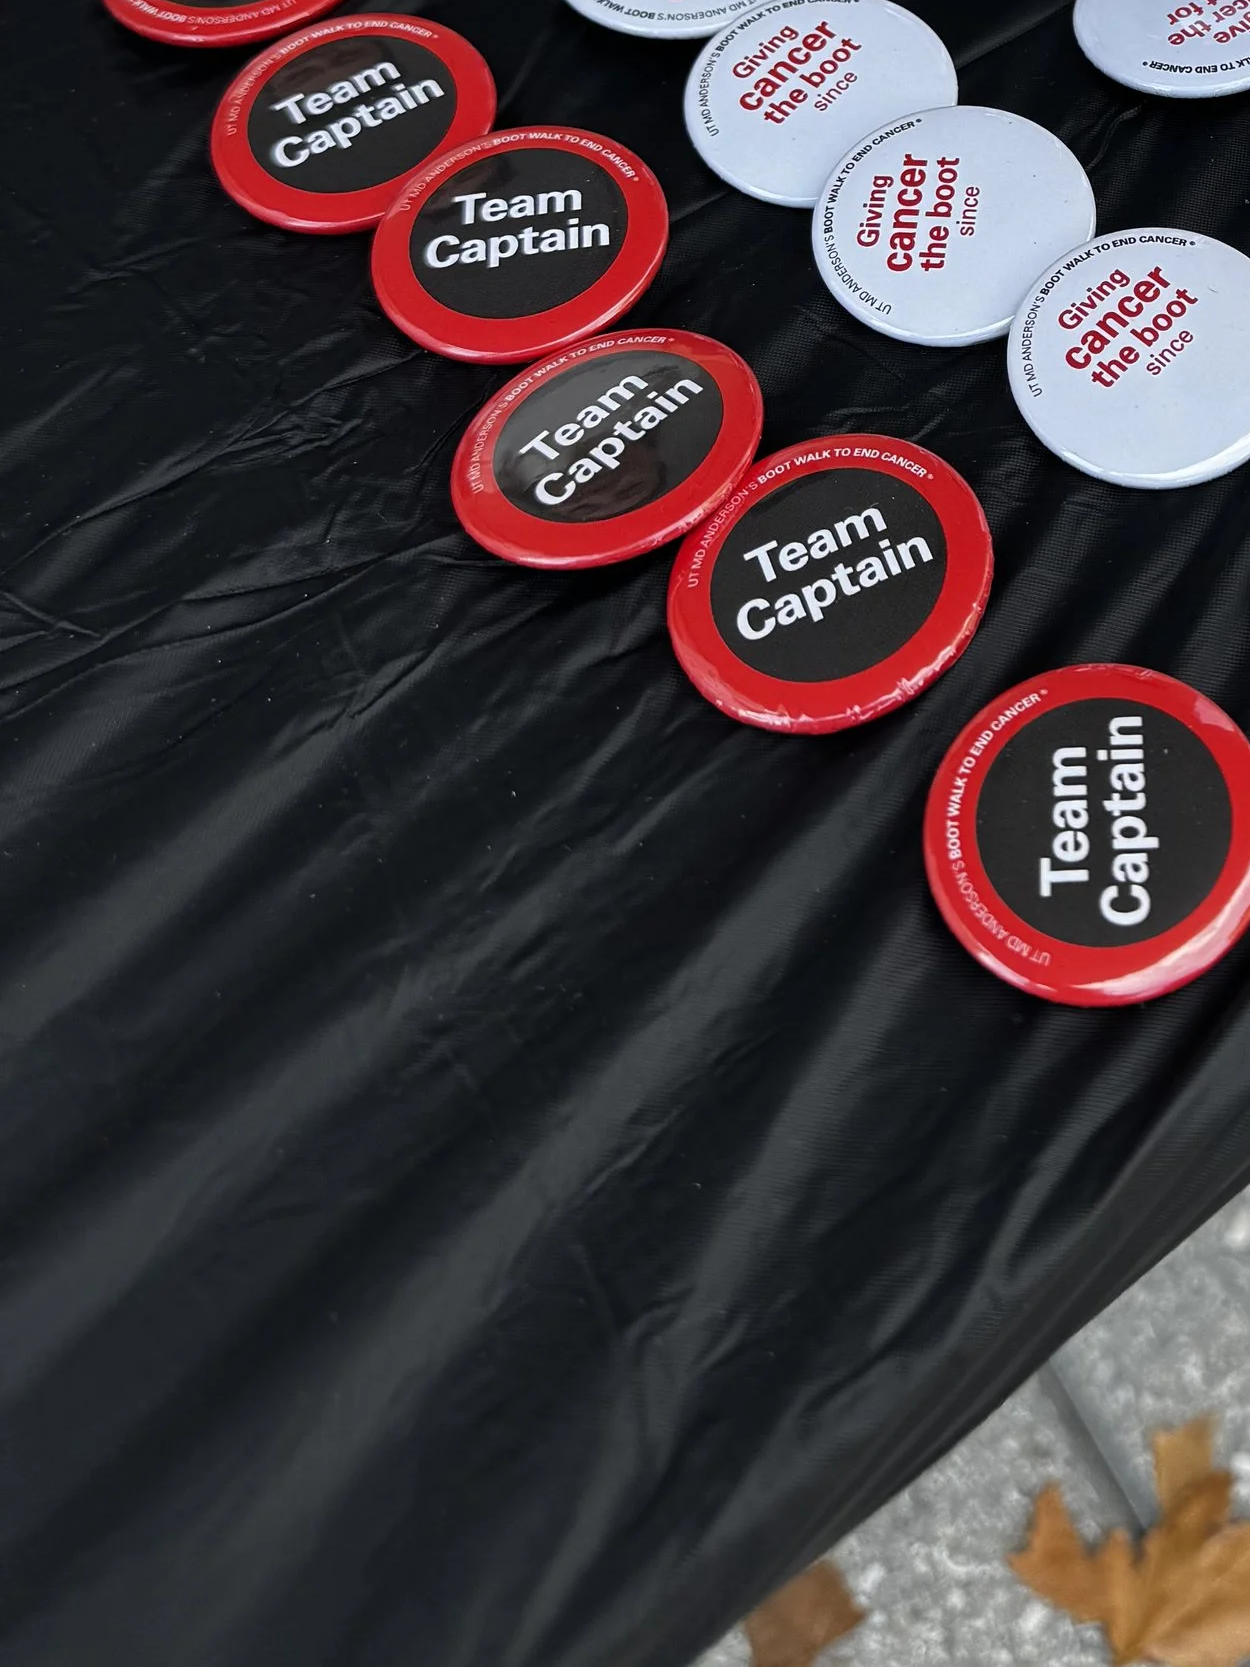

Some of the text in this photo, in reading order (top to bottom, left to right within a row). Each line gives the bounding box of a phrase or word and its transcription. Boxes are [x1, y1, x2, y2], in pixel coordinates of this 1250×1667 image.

[1167, 2, 1204, 25] for
[1167, 19, 1212, 46] the
[732, 24, 800, 80] Giving
[738, 20, 842, 112] cancer
[764, 37, 862, 125] the boot
[271, 61, 401, 126] Team
[273, 76, 445, 169] Captain
[814, 71, 859, 112] since
[453, 188, 583, 226] Team
[857, 175, 894, 248] Giving
[887, 154, 928, 273] cancer
[919, 157, 961, 273] the boot
[957, 186, 981, 237] since
[423, 218, 611, 270] Captain
[1057, 268, 1130, 331] Giving
[1065, 266, 1171, 370] cancer
[1091, 287, 1199, 389] the boot
[1146, 329, 1194, 376] since
[519, 375, 650, 462] Team
[534, 377, 704, 507] Captain
[757, 461, 791, 485] BOOT
[793, 449, 831, 465] WALK
[834, 448, 851, 457] TO
[853, 448, 880, 459] END
[691, 549, 706, 570] MD
[743, 507, 888, 583] Team
[688, 571, 700, 587] UT
[736, 536, 934, 641] Captain
[1039, 746, 1090, 898] Team
[1097, 715, 1160, 927] Captain
